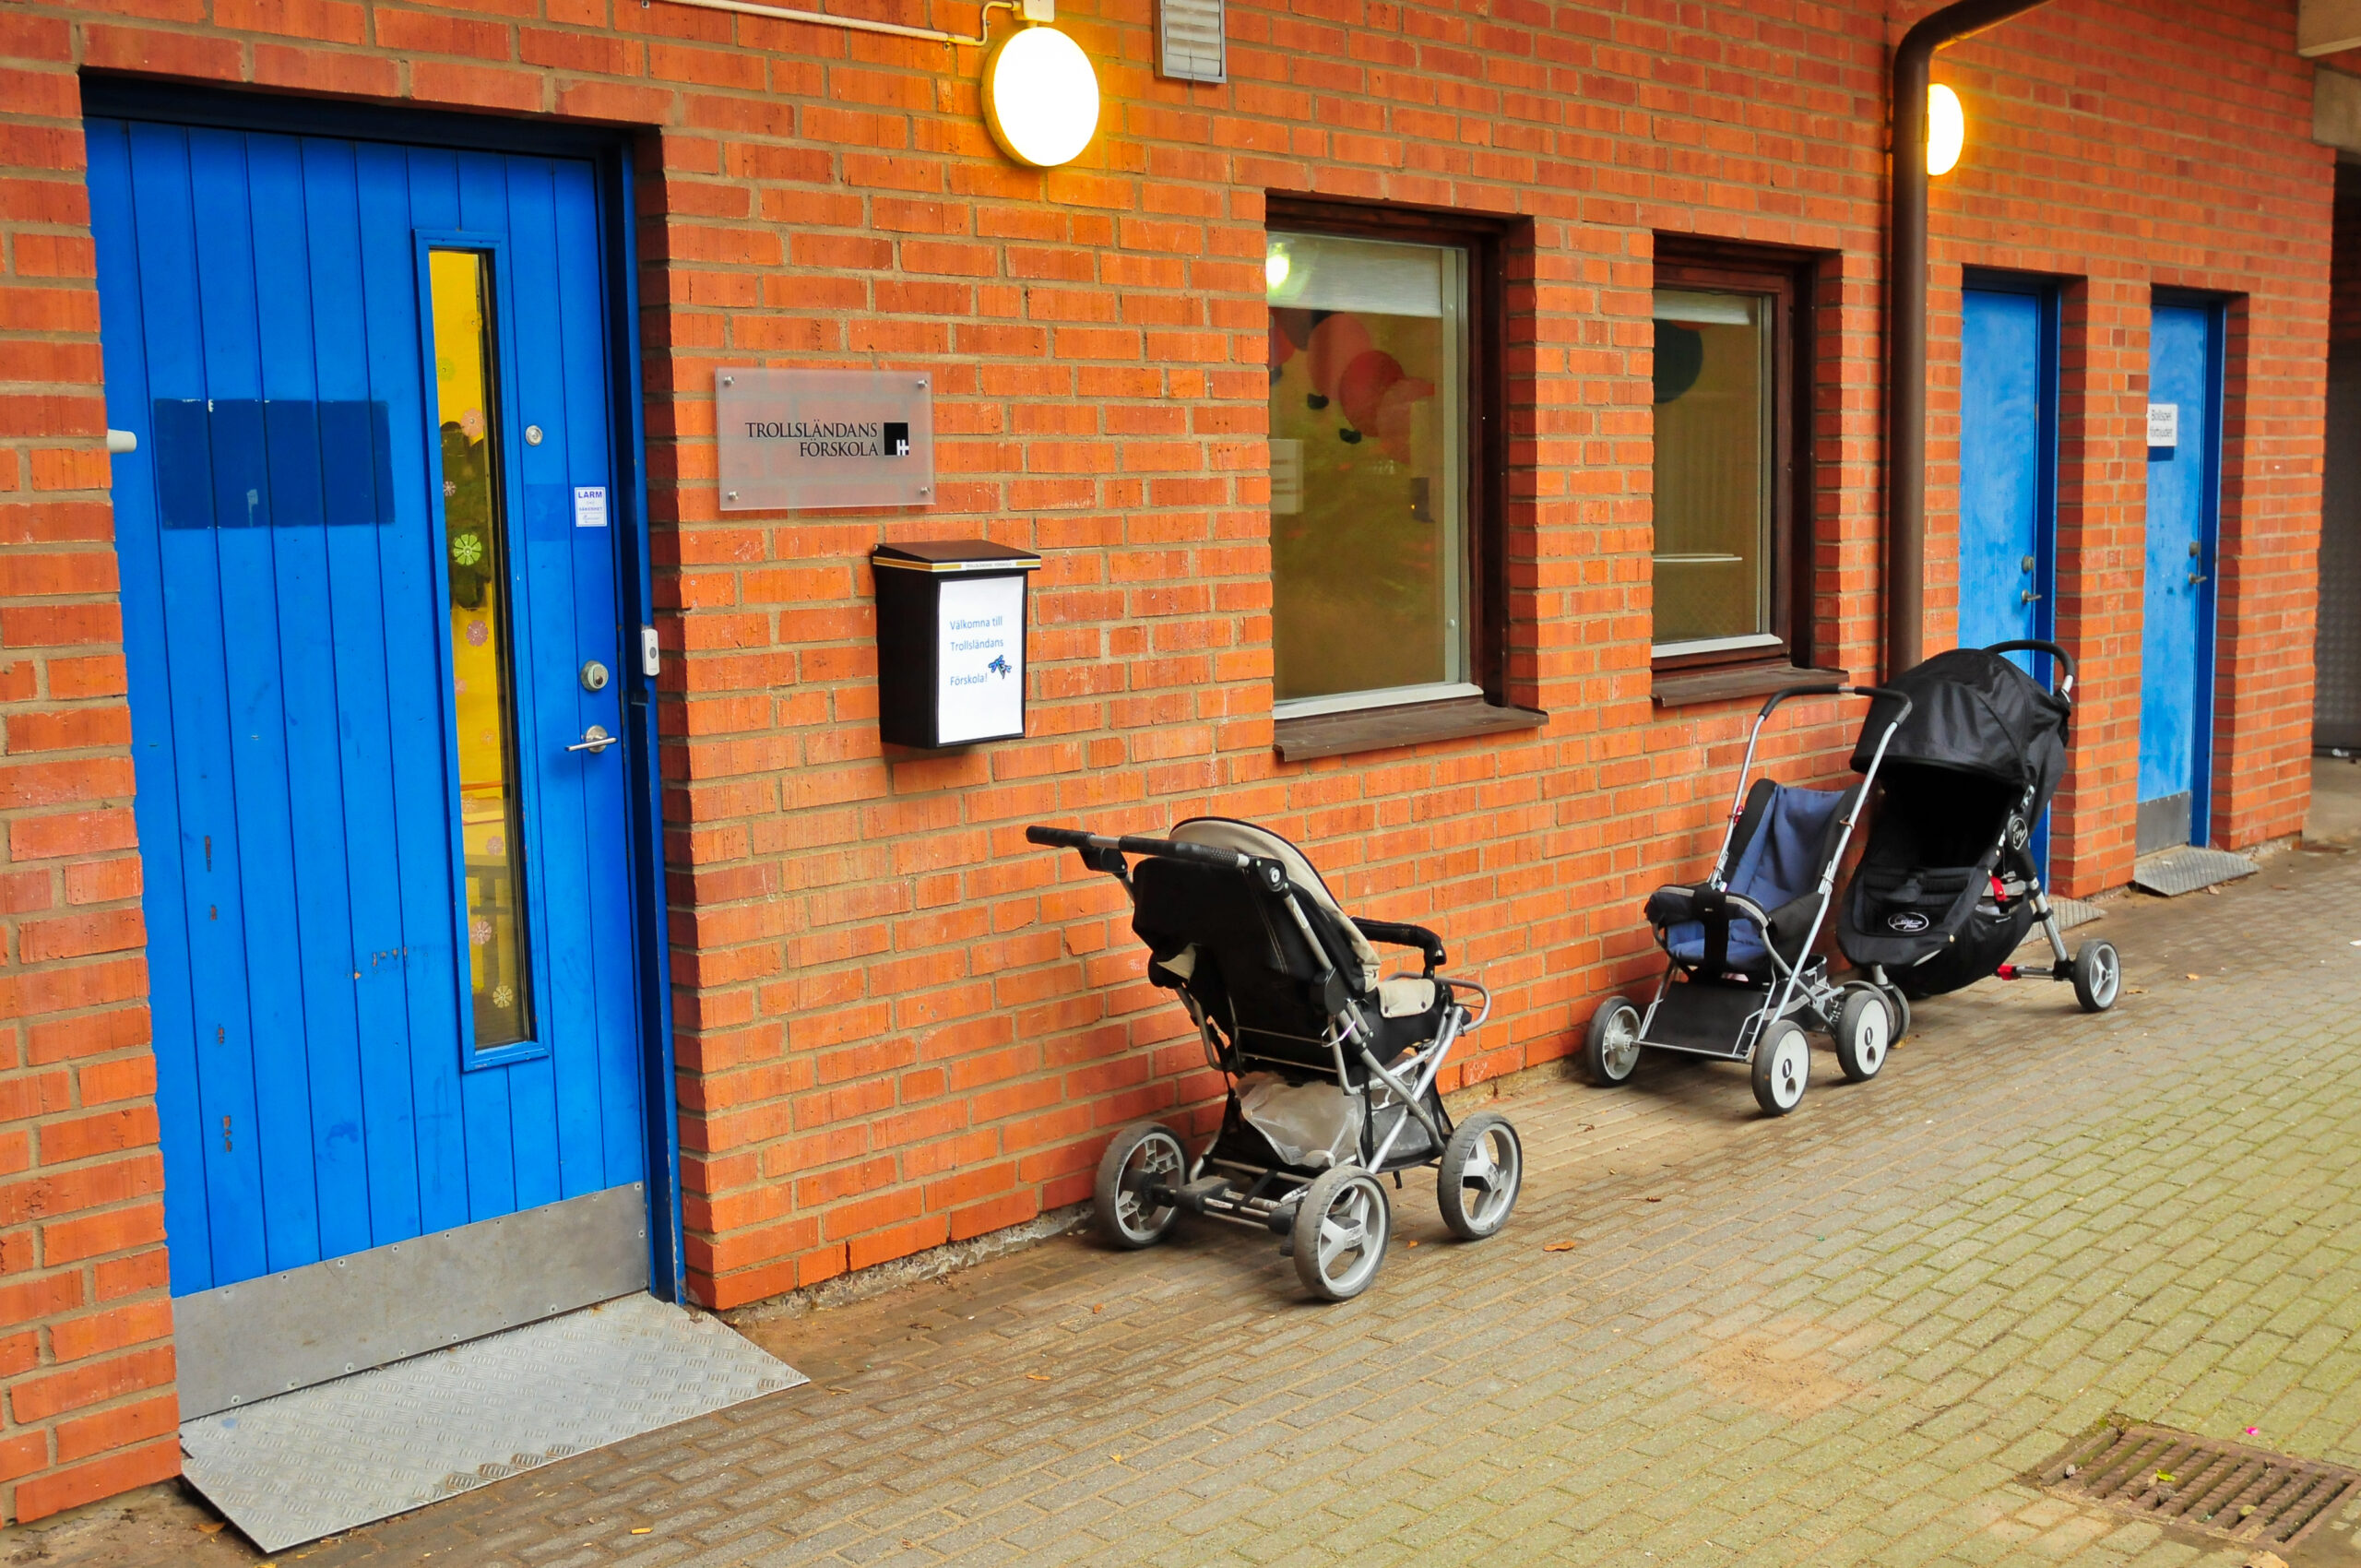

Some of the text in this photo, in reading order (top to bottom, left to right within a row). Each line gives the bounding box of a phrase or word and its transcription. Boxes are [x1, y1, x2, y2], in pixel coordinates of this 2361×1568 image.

[745, 419, 878, 438] TROLLSLÄNDANS
[800, 438, 878, 457] FÖRSKOLA
[578, 491, 602, 499] LARM
[950, 615, 1003, 631] Välkomna till
[950, 638, 1004, 652] Trollsländans
[950, 673, 988, 686] Förskola!
